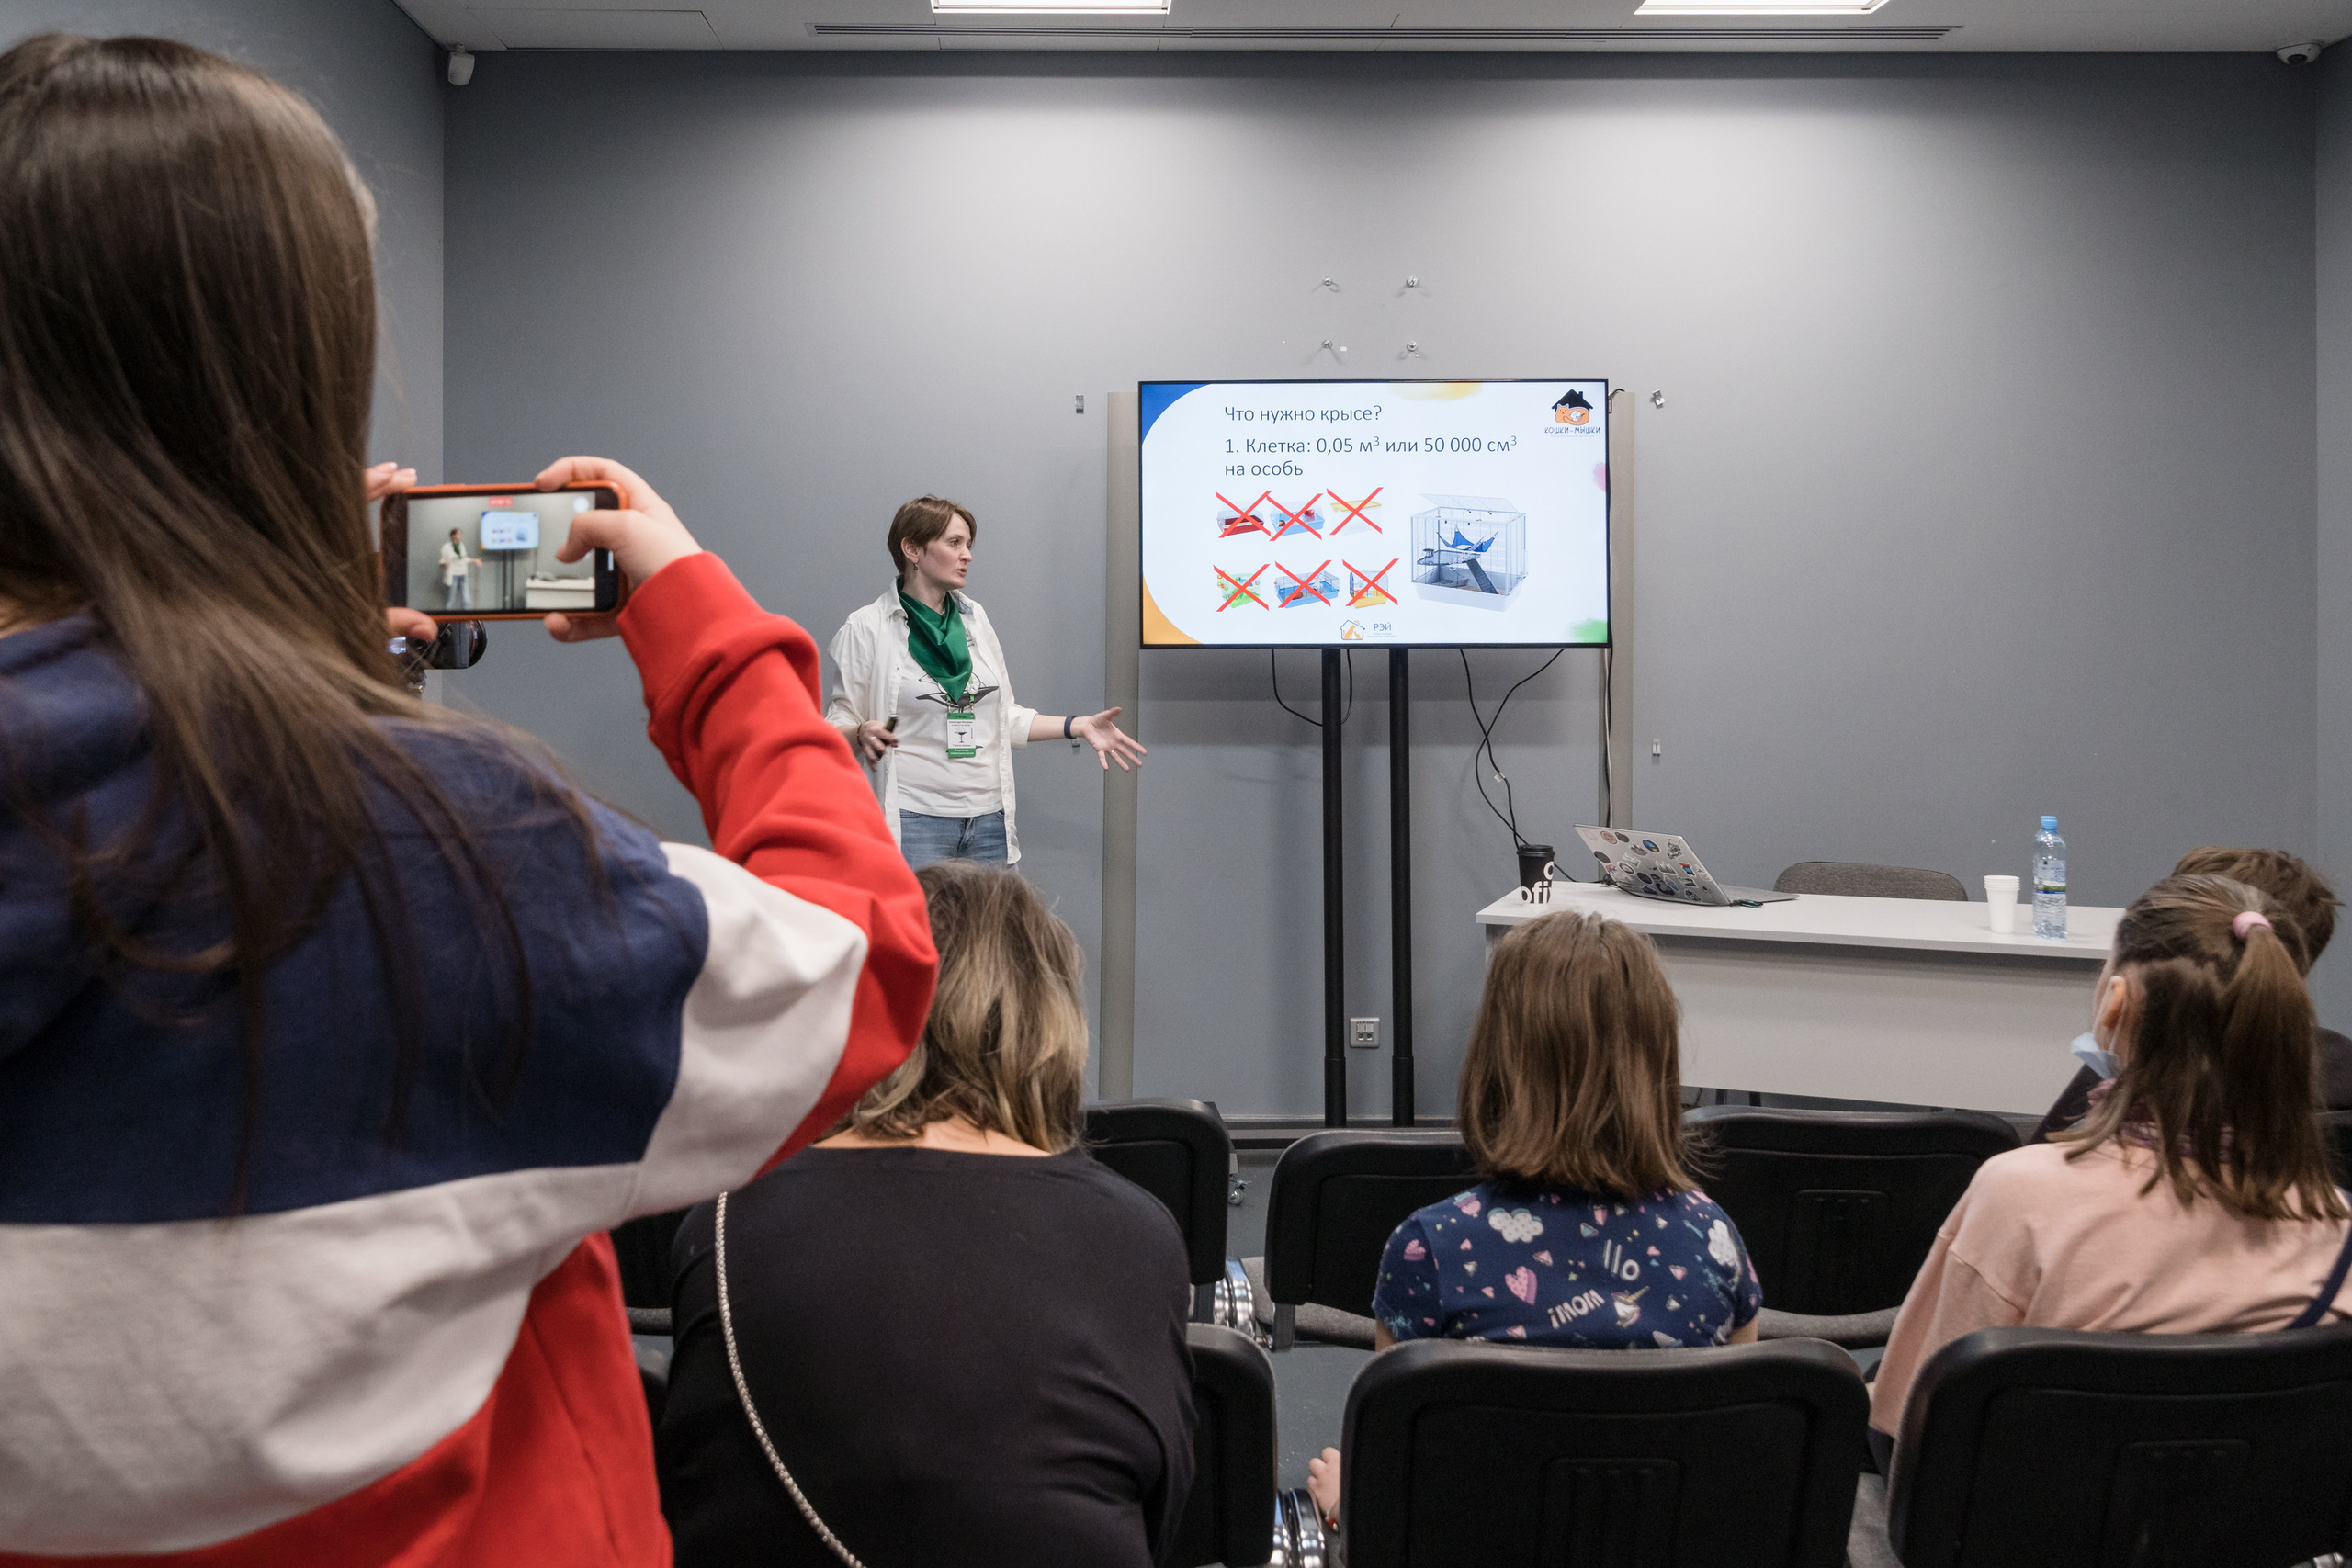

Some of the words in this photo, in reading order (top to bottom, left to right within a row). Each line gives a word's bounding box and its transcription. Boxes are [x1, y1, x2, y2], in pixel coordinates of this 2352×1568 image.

[1225, 406, 1255, 422] Что
[1260, 409, 1316, 424] нужно
[1320, 405, 1382, 424] крысе?
[1225, 438, 1239, 454] 1.
[1246, 438, 1311, 454] Клетка:
[1317, 437, 1353, 455] 0,05
[1385, 441, 1418, 453] или
[1424, 437, 1445, 453] 50
[1450, 437, 1482, 453] 000
[1225, 464, 1245, 476] на
[1250, 460, 1304, 476] особь
[1374, 622, 1392, 632] РЭЙ
